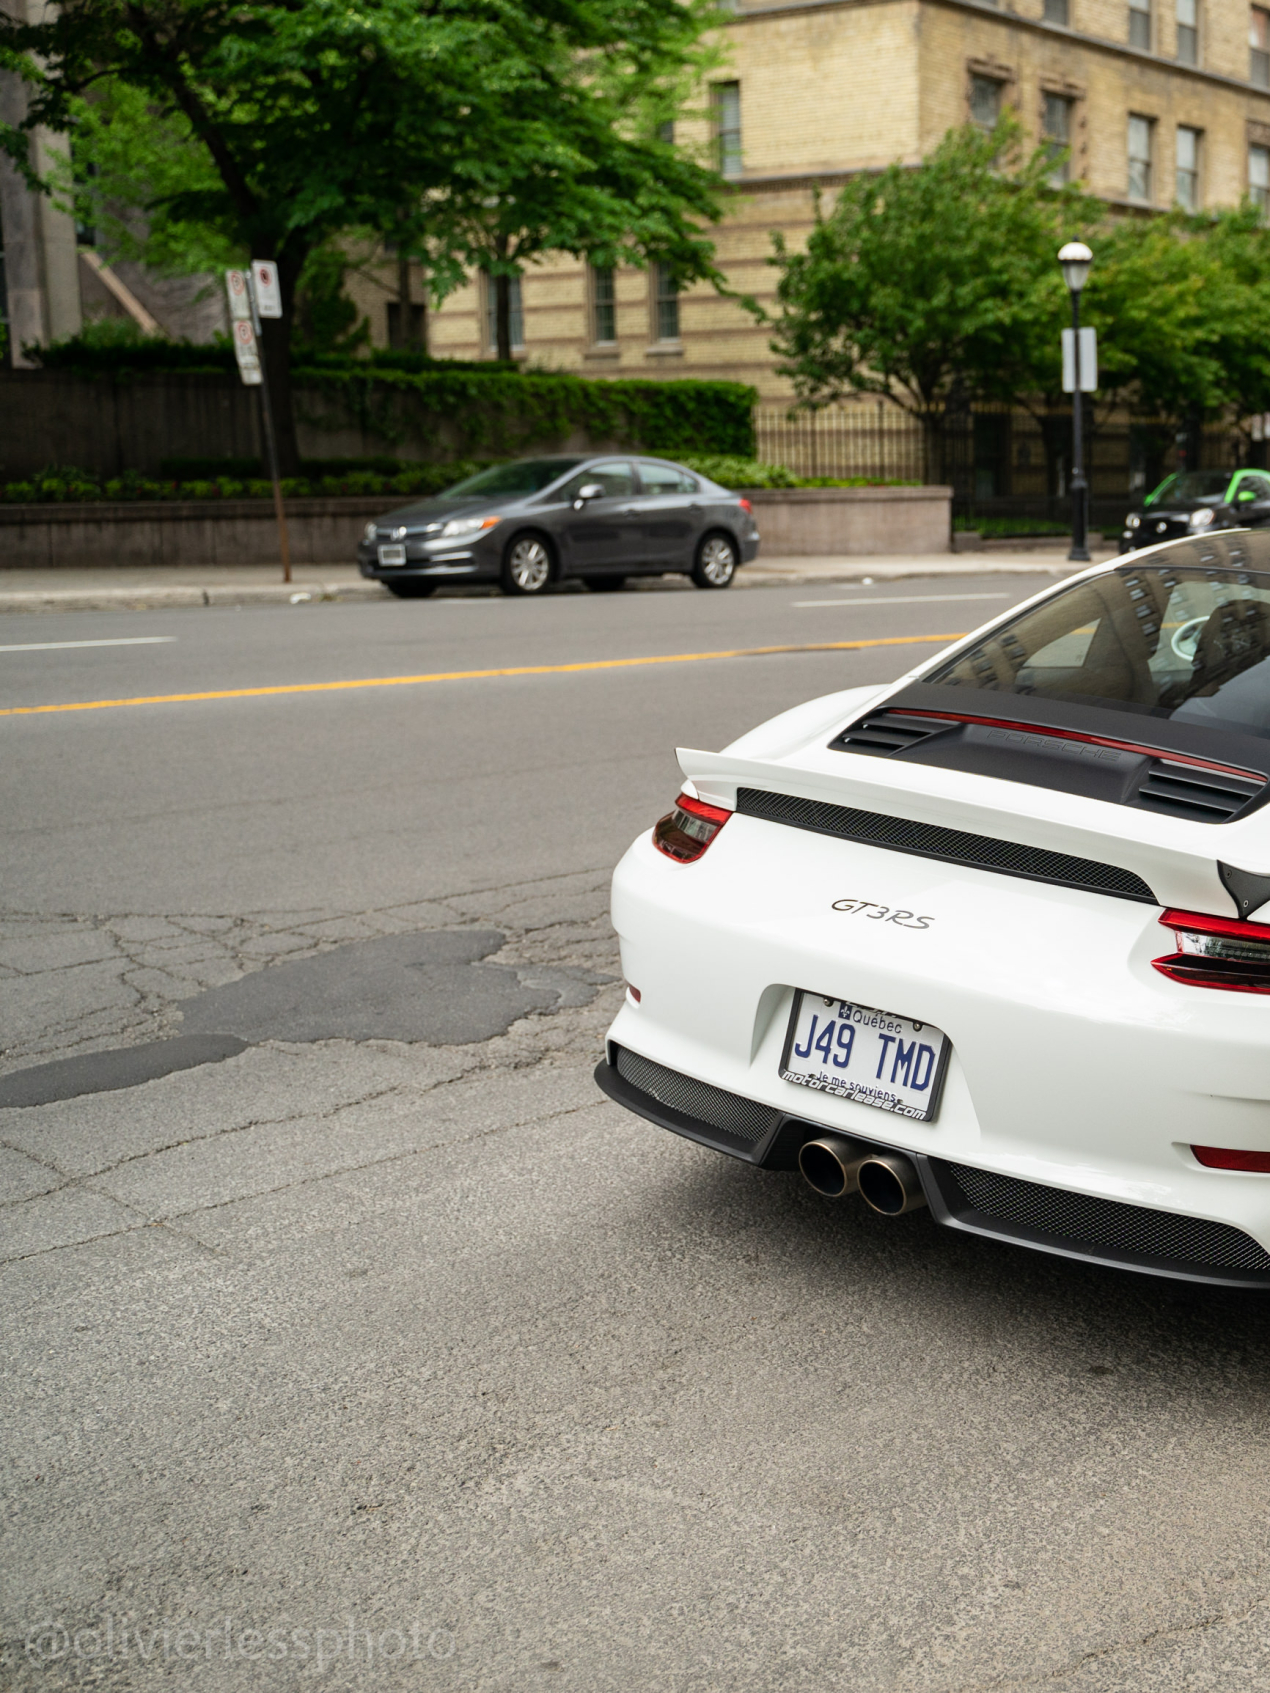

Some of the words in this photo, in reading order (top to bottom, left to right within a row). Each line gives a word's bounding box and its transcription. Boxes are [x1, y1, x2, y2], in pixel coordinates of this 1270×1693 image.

[986, 729, 1122, 762] PORSCHE
[852, 1009, 903, 1034] Québec
[794, 1014, 856, 1069] J49
[875, 1032, 936, 1092] TMD
[781, 1070, 927, 1120] motorcarlease.com
[831, 1075, 847, 1088] me
[849, 1080, 897, 1103] souviens
